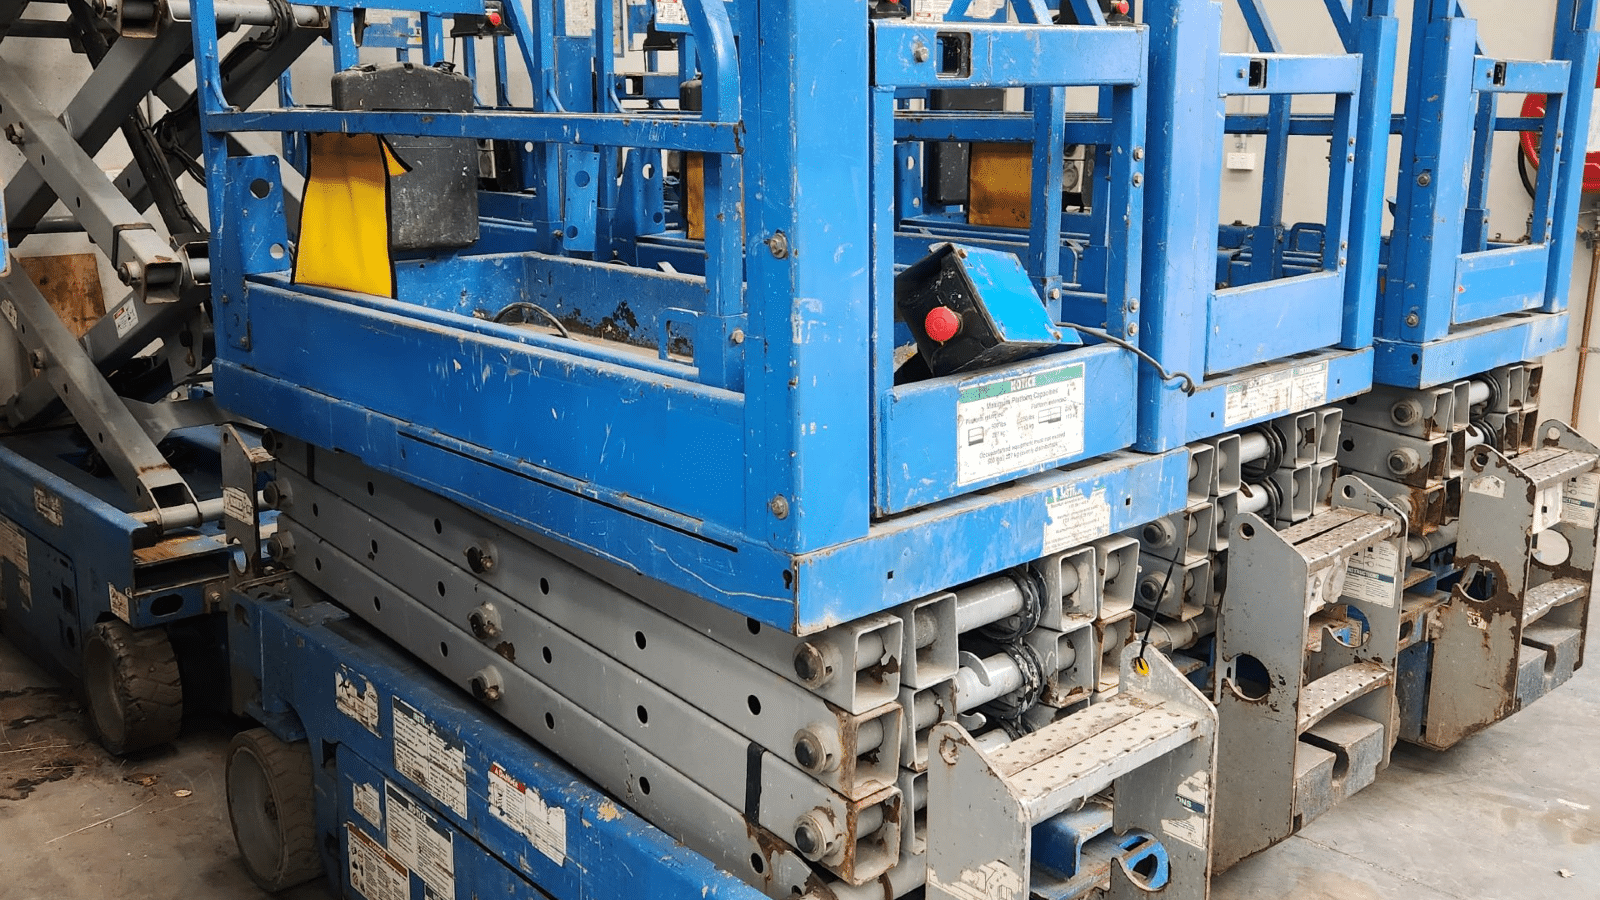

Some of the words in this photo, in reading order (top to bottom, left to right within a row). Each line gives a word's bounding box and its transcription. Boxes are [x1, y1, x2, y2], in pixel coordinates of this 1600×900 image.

[1011, 377, 1035, 390] NOTICE
[987, 398, 1010, 410] Maximum
[1012, 393, 1032, 403] Platform
[1033, 388, 1058, 398] Capacities
[408, 801, 427, 823] NOTICE
